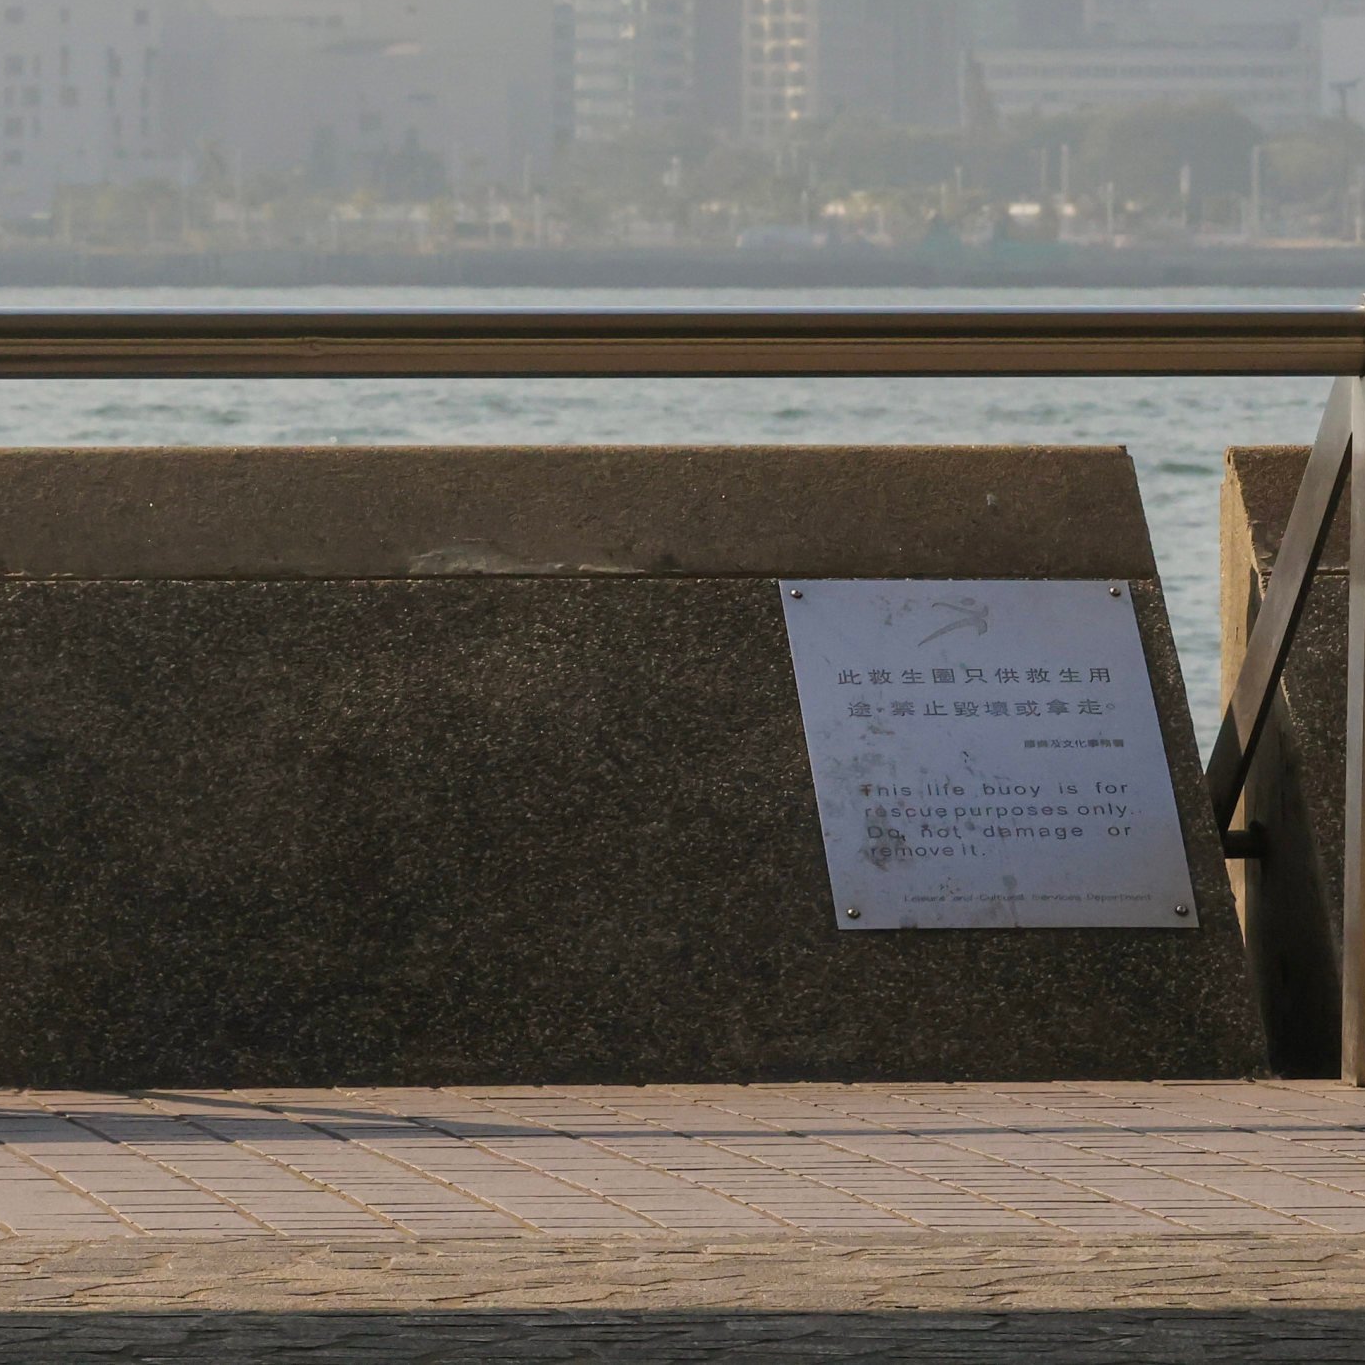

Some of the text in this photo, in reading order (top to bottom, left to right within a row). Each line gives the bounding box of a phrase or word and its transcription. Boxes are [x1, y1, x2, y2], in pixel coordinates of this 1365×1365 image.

[838, 667, 1111, 685] 此救生圈只供救生用
[860, 782, 1128, 798] This life buoy is for
[864, 806, 947, 818] rescue
[955, 805, 1068, 819] purposes
[921, 825, 960, 839] not
[983, 825, 1083, 839] damage
[1107, 826, 1132, 837] or
[871, 843, 986, 856] remove it.
